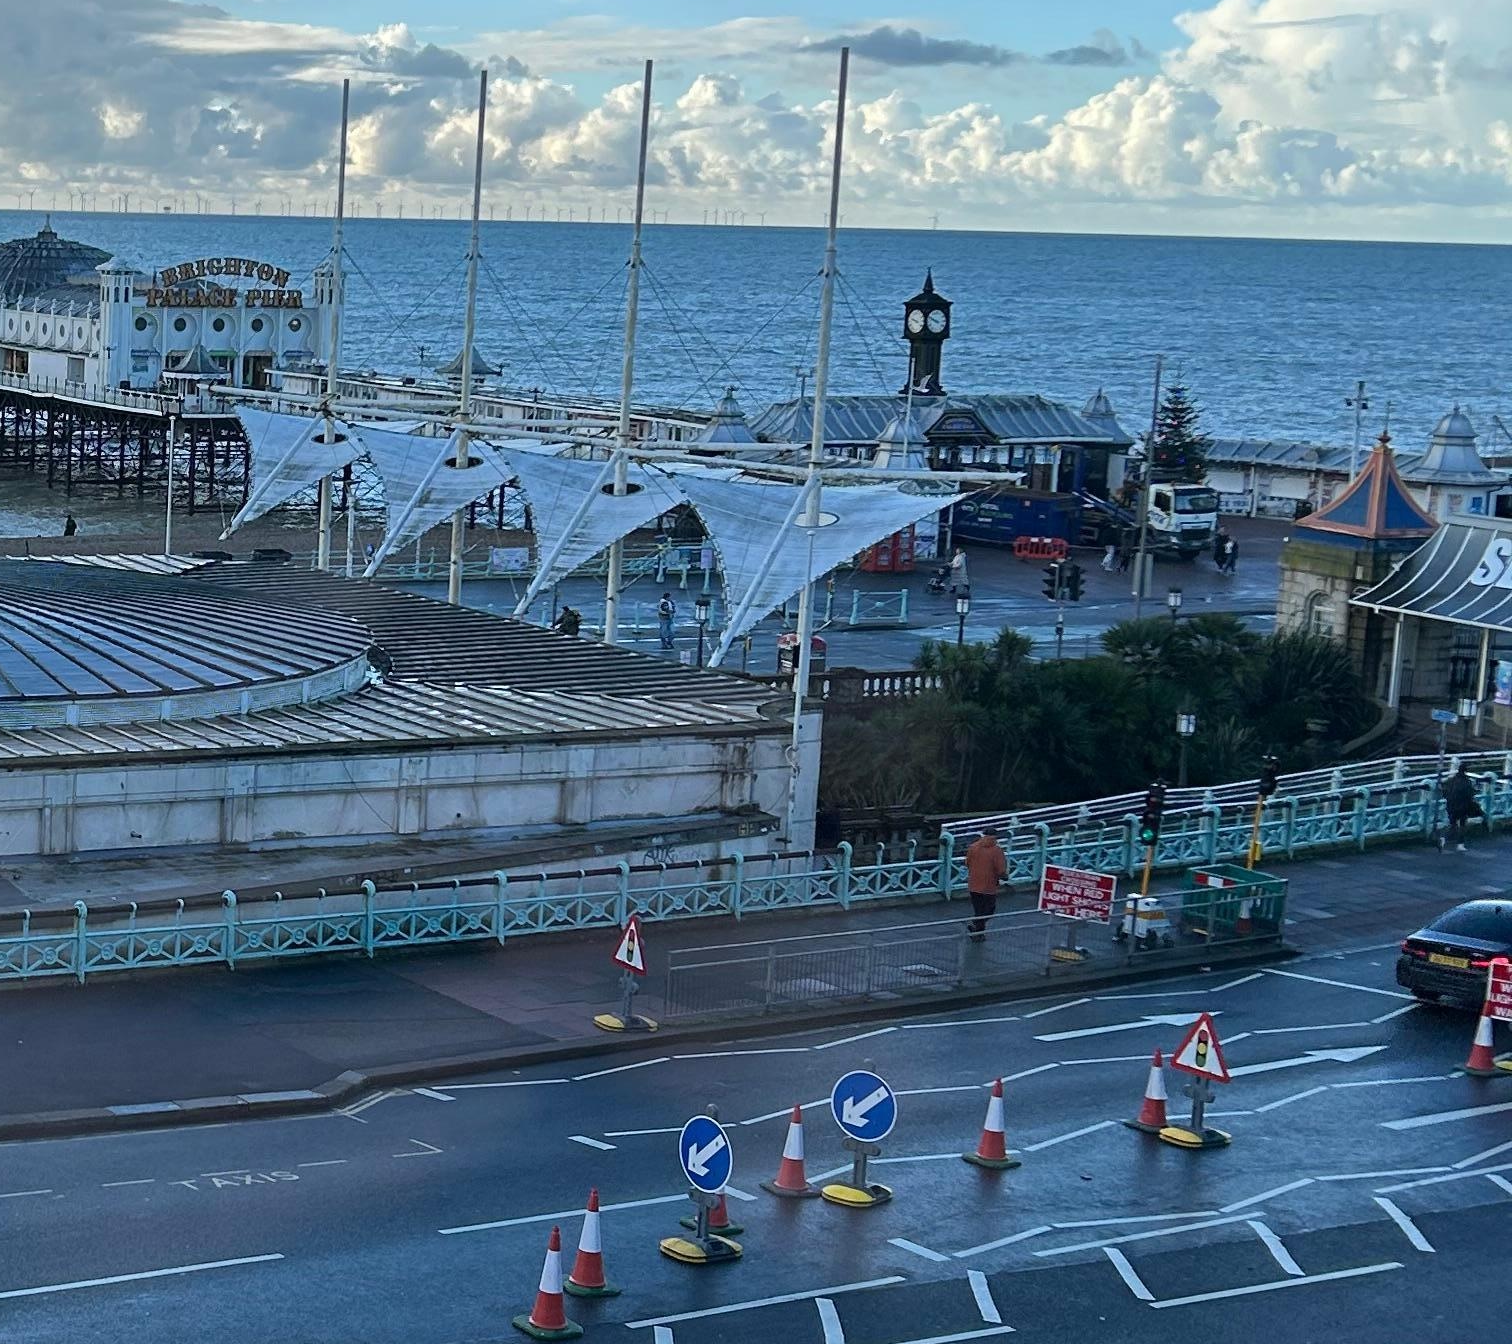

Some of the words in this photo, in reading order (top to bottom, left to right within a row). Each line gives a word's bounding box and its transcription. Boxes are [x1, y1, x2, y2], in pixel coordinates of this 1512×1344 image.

[160, 257, 291, 288] BRIGHTON
[146, 288, 237, 307] PALACE
[245, 289, 303, 309] PIER
[1052, 883, 1083, 895] WHEN
[1083, 888, 1104, 899] RED
[168, 1170, 300, 1191] TAXIS
